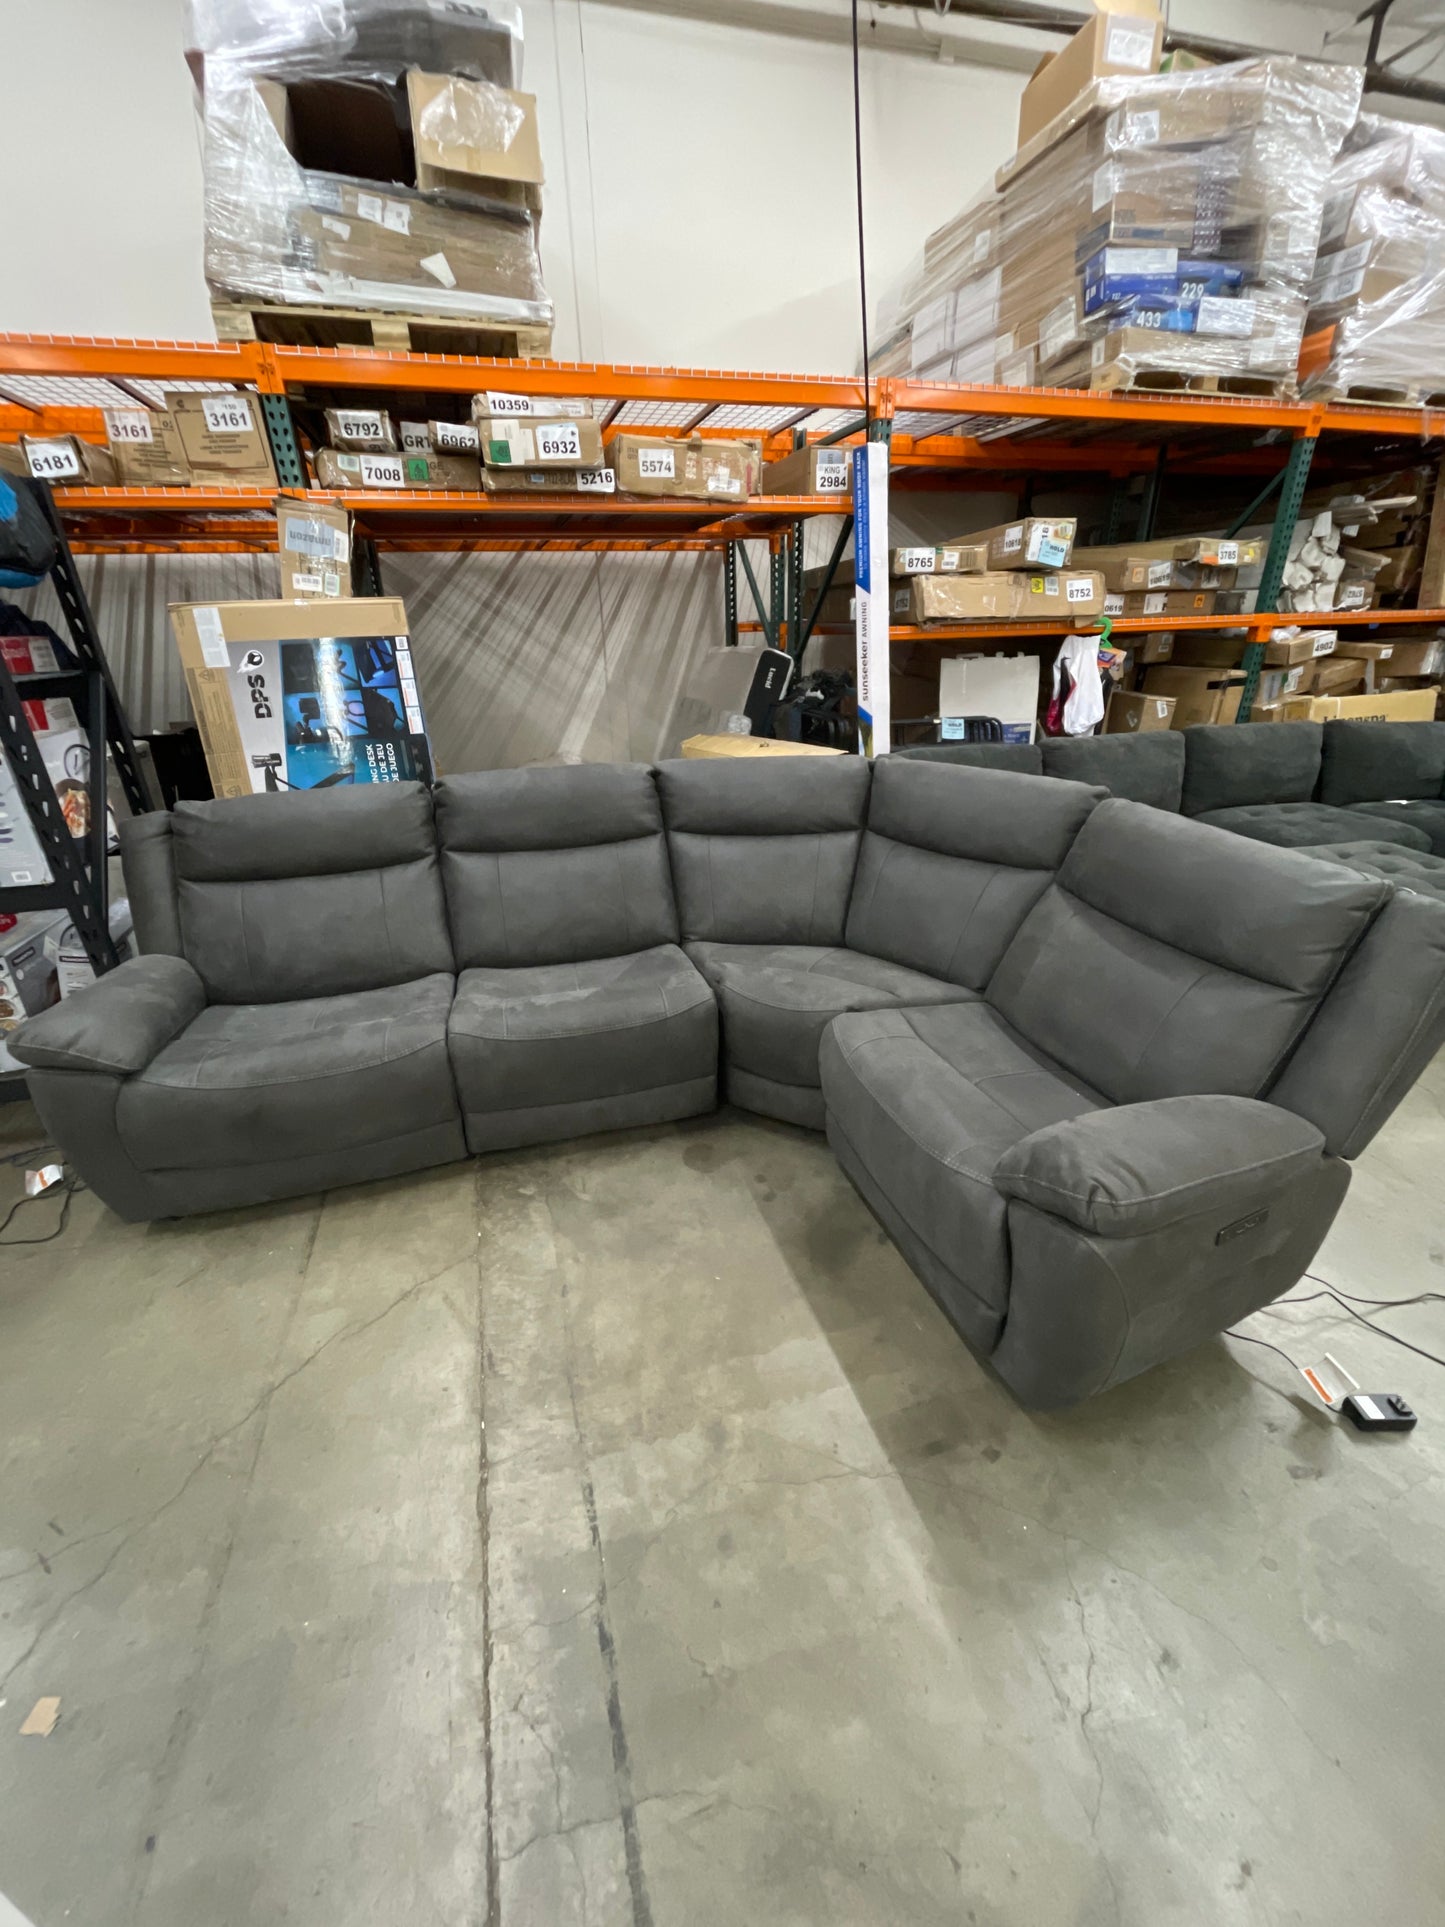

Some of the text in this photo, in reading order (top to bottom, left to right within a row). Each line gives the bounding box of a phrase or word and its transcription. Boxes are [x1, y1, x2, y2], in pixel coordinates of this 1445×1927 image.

[1181, 282, 1204, 299] 229
[1136, 311, 1162, 328] 433
[490, 399, 529, 411] 10359
[210, 412, 247, 427] 3161
[111, 424, 148, 438] 3161
[344, 423, 380, 436] 6792
[441, 434, 476, 449] 6962
[543, 441, 577, 454] 6932
[32, 454, 73, 472] 6181
[641, 459, 672, 473] 5574
[824, 466, 841, 474] KING
[365, 466, 401, 481] 7008
[581, 471, 613, 485] 5216
[820, 476, 846, 487] 2984
[907, 557, 933, 568] 8765
[1219, 551, 1237, 560] 3785
[1068, 588, 1092, 599] 8752
[1104, 604, 1123, 612] 0619
[1314, 641, 1334, 651] 4902
[764, 667, 777, 689] Lucid
[861, 641, 869, 702] sunseeker
[248, 674, 272, 719] DPS
[375, 744, 385, 760] JEU
[386, 743, 398, 771] JUEGO
[365, 744, 379, 784] ING DESK
[379, 761, 388, 773] DE
